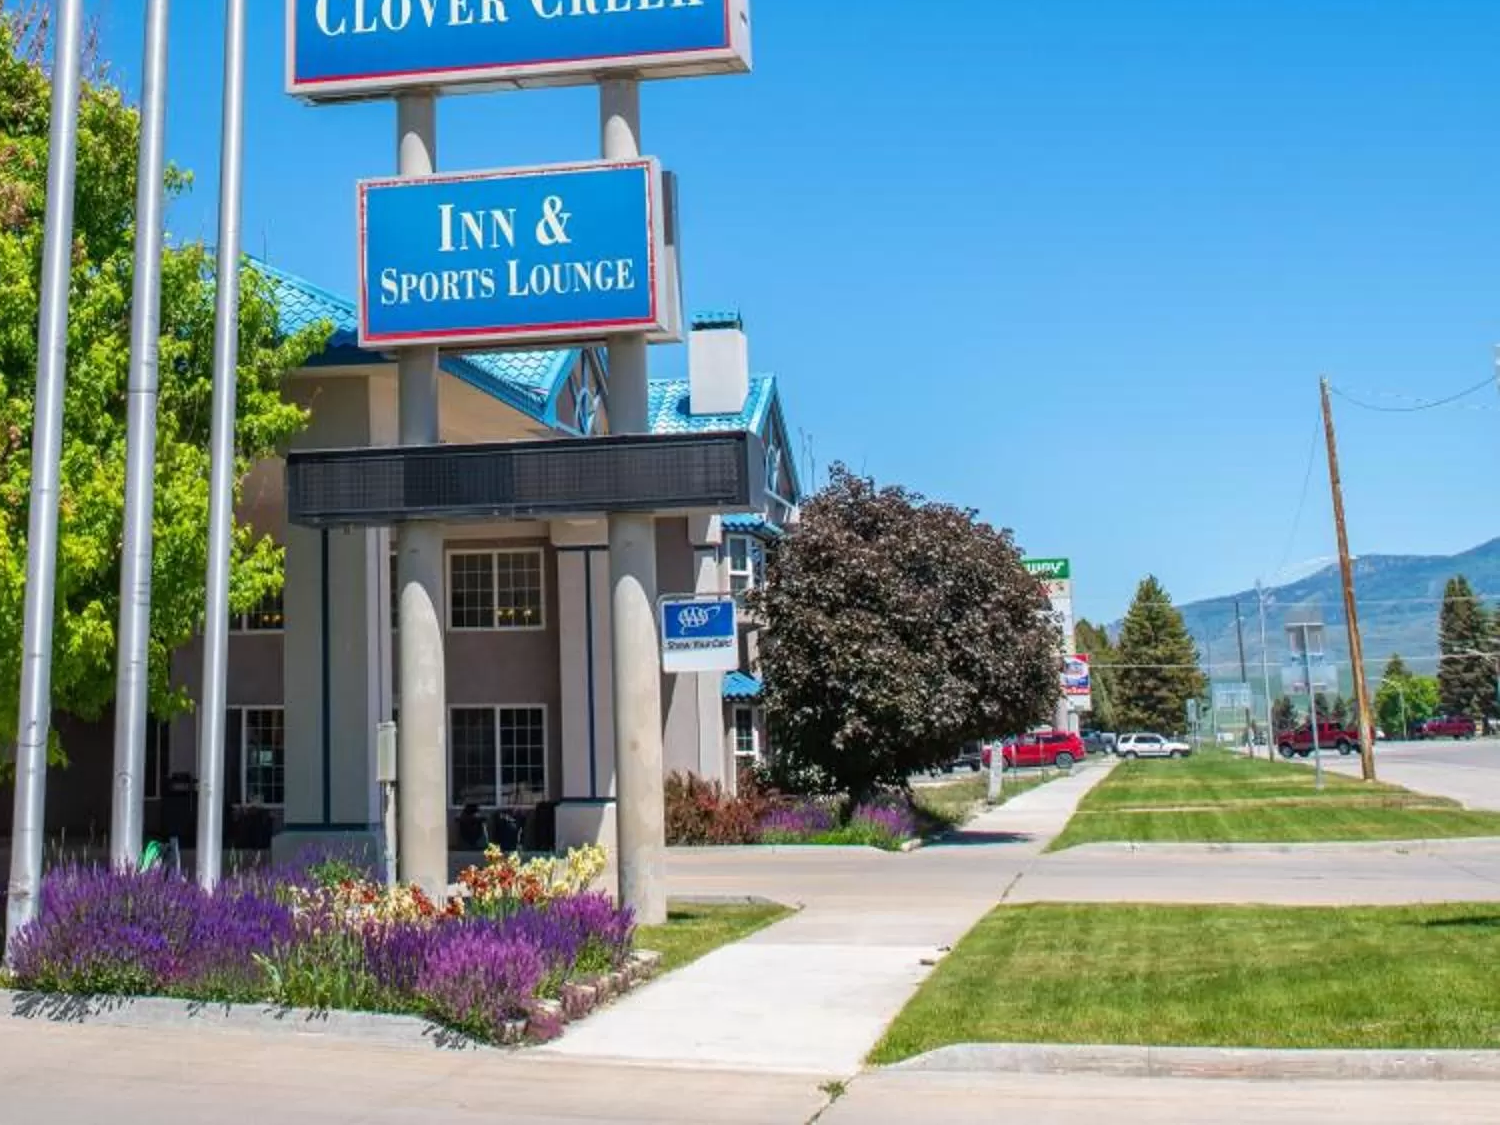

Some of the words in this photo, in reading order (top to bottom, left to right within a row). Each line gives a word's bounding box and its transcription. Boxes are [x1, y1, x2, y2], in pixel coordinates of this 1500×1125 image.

[438, 203, 516, 252] INN
[535, 195, 572, 246] &
[380, 268, 496, 305] SPORTS
[507, 259, 635, 297] LOUNGE
[678, 606, 709, 628] AAA
